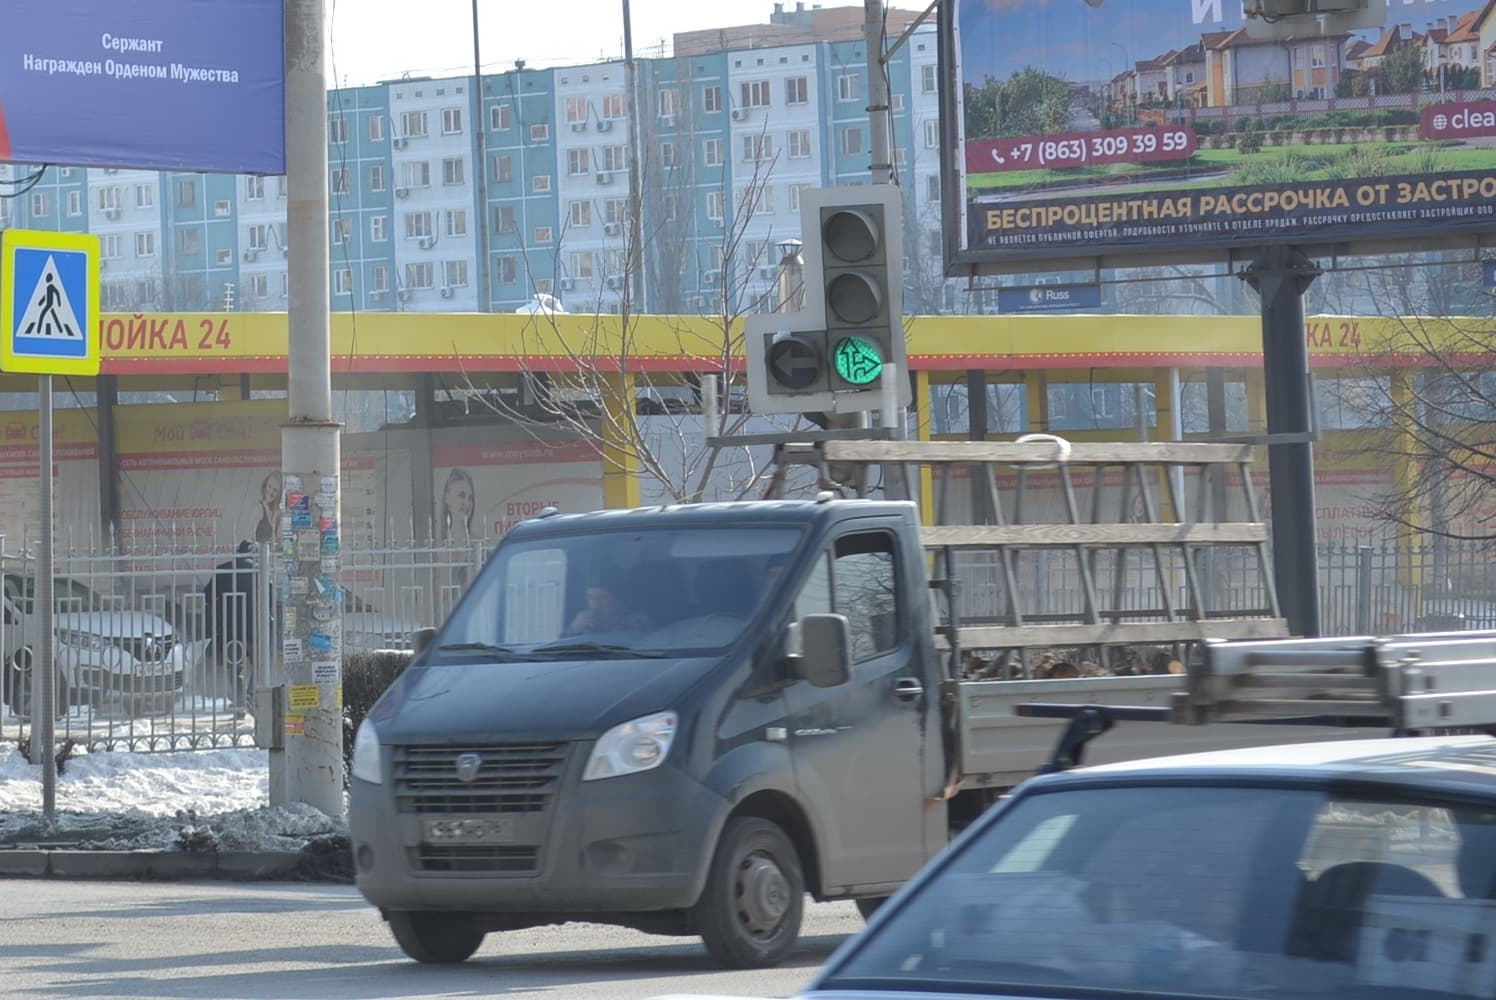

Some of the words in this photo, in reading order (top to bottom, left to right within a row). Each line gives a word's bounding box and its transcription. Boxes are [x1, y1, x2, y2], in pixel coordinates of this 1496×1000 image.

[102, 33, 163, 53] Сержант
[23, 54, 101, 75] Награжден
[105, 59, 167, 79] Орденом
[170, 63, 239, 83] Мужества
[1011, 144, 1032, 161] +7
[1038, 138, 1086, 164] (863)
[1092, 136, 1127, 157] 309
[1132, 134, 1156, 153] 39
[1162, 131, 1187, 151] 59
[986, 197, 1191, 230] БЕСПРОЦЕНТНАЯ
[1199, 187, 1349, 216] РАССРОЧКА
[1357, 184, 1390, 205] ОТ
[1397, 177, 1496, 203] ЗАСТРО
[1232, 218, 1262, 230] ОТДЕЛЕ
[1304, 214, 1347, 225] РАССРОЧКУ
[1351, 209, 1416, 222] ПРЕДОСТАВЛЯЕТ
[1420, 205, 1474, 218] ЗАСТРОЙЩИК
[1046, 290, 1070, 300] Russ
[100, 314, 188, 350] ОЙКА
[198, 319, 231, 350] 24
[1339, 322, 1360, 348] 24
